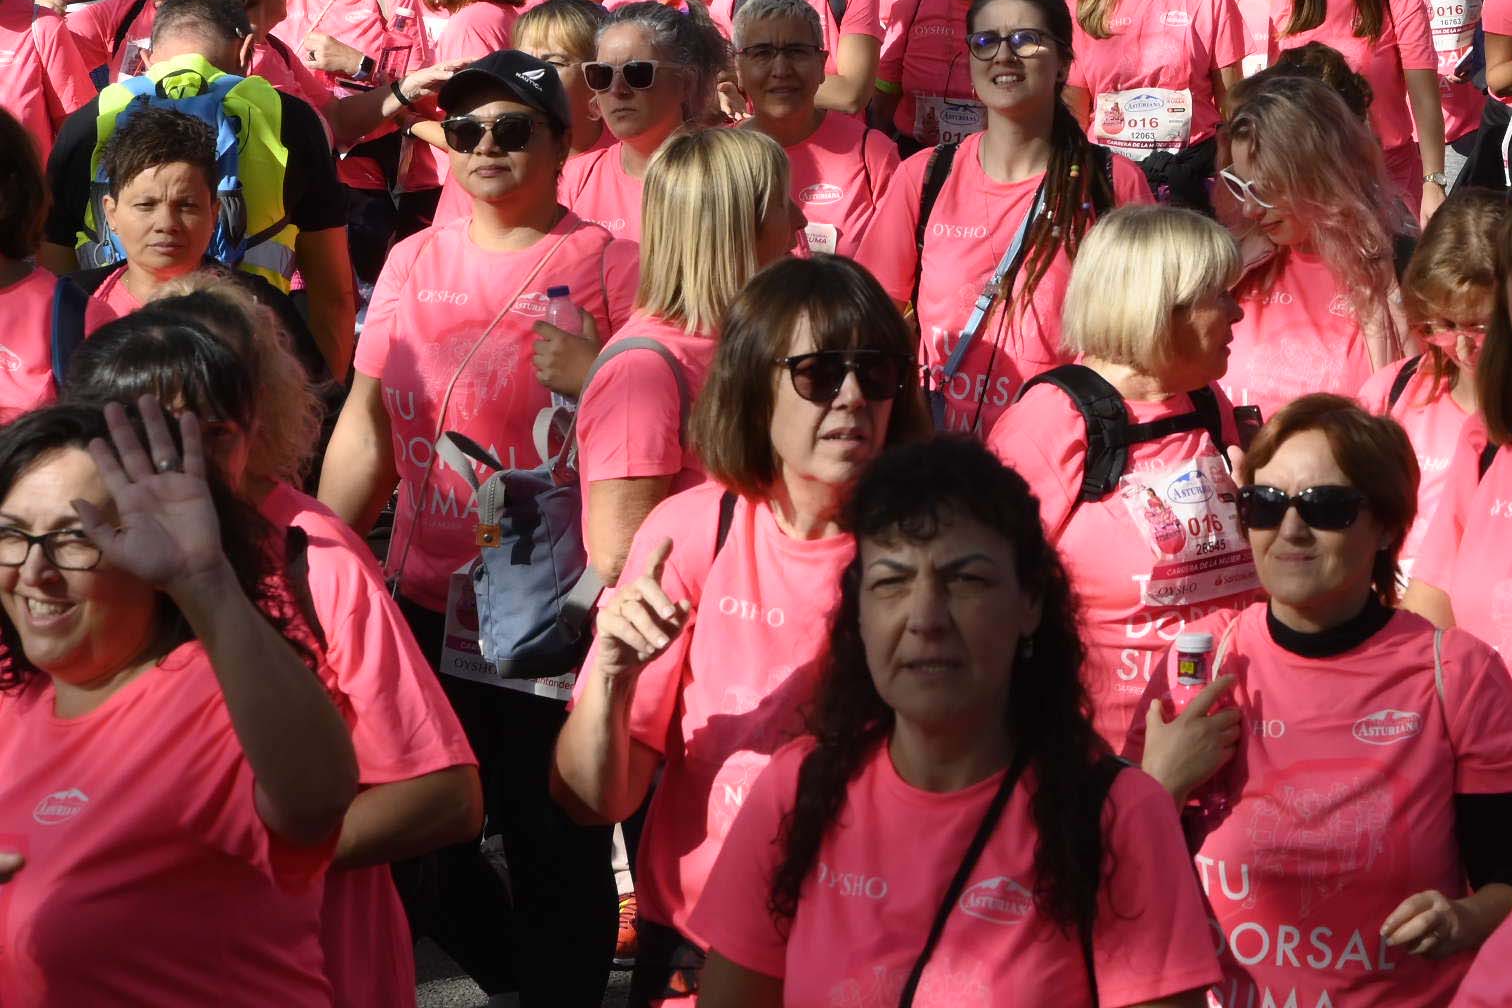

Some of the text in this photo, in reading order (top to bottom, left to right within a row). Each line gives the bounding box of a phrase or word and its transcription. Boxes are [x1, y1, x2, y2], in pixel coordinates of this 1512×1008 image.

[1437, 4, 1464, 17] 016
[1440, 18, 1462, 26] 16763
[515, 72, 543, 92] NAUTICA
[1127, 117, 1159, 129] 016
[1131, 132, 1155, 140] 12063
[1106, 139, 1132, 148] CARRERA
[933, 223, 987, 239] OYSHO
[1187, 513, 1224, 537] 016
[1358, 712, 1422, 738] ASTURIANA
[1197, 855, 1251, 901] TU
